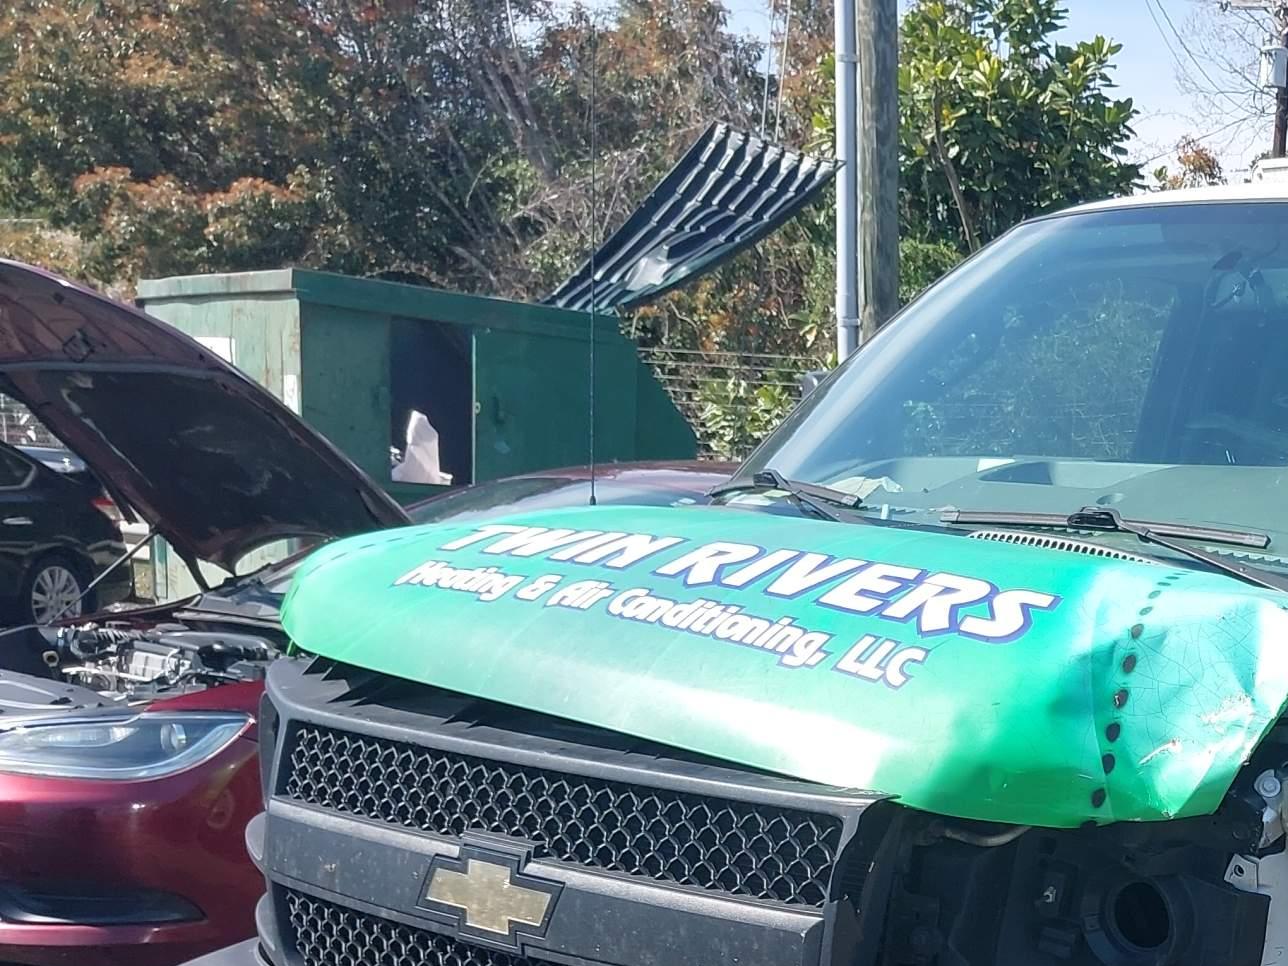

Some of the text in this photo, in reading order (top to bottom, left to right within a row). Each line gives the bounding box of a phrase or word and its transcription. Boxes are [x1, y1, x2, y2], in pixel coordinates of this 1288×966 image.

[392, 559, 931, 689] Heating & Air Conditioning, LLC
[436, 523, 1062, 643] TWIN RIVERS
